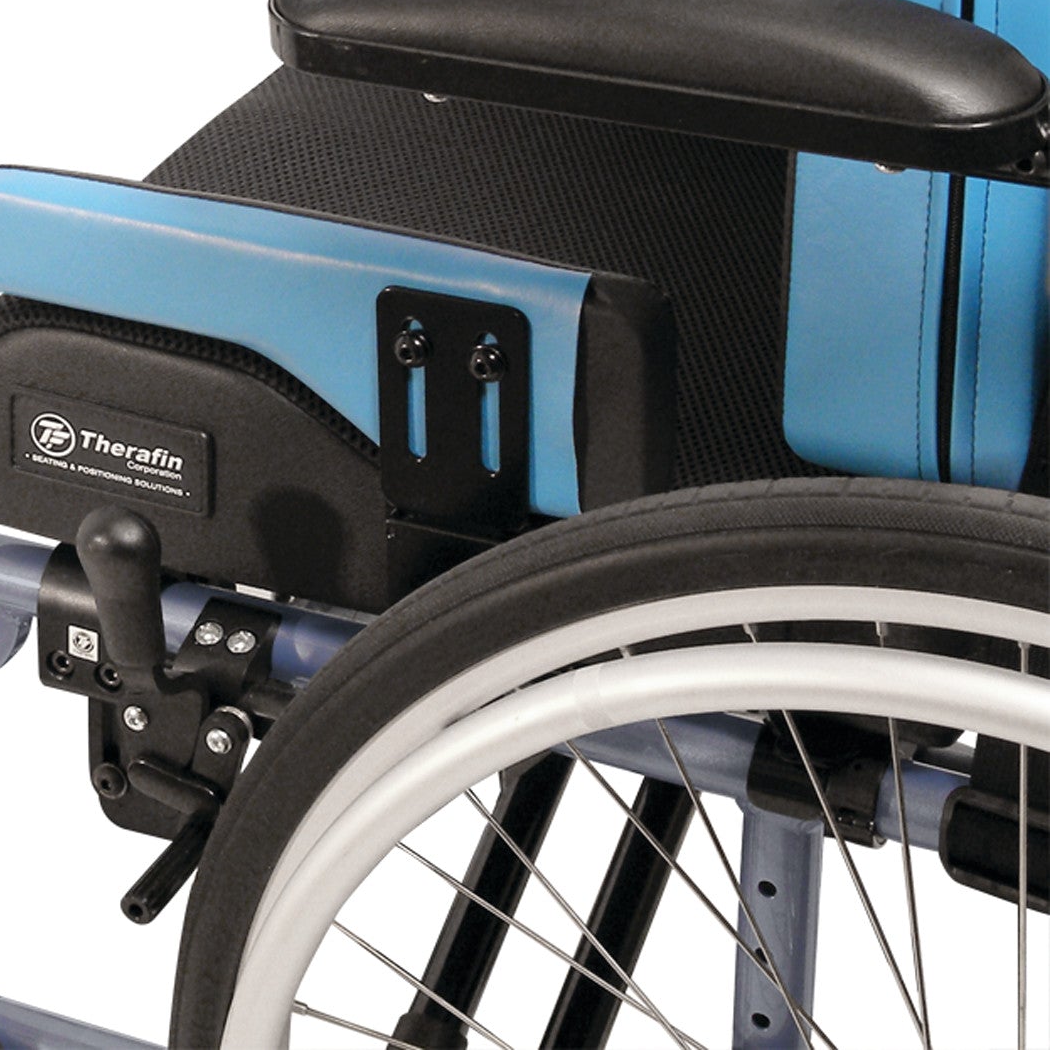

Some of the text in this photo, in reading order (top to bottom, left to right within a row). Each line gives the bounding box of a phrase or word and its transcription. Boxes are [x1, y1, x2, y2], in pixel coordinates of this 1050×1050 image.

[80, 428, 184, 471] Therafin
[126, 458, 183, 481] Corporation
[31, 452, 184, 497] SEATING & POSITIONING SOLUTIONS
